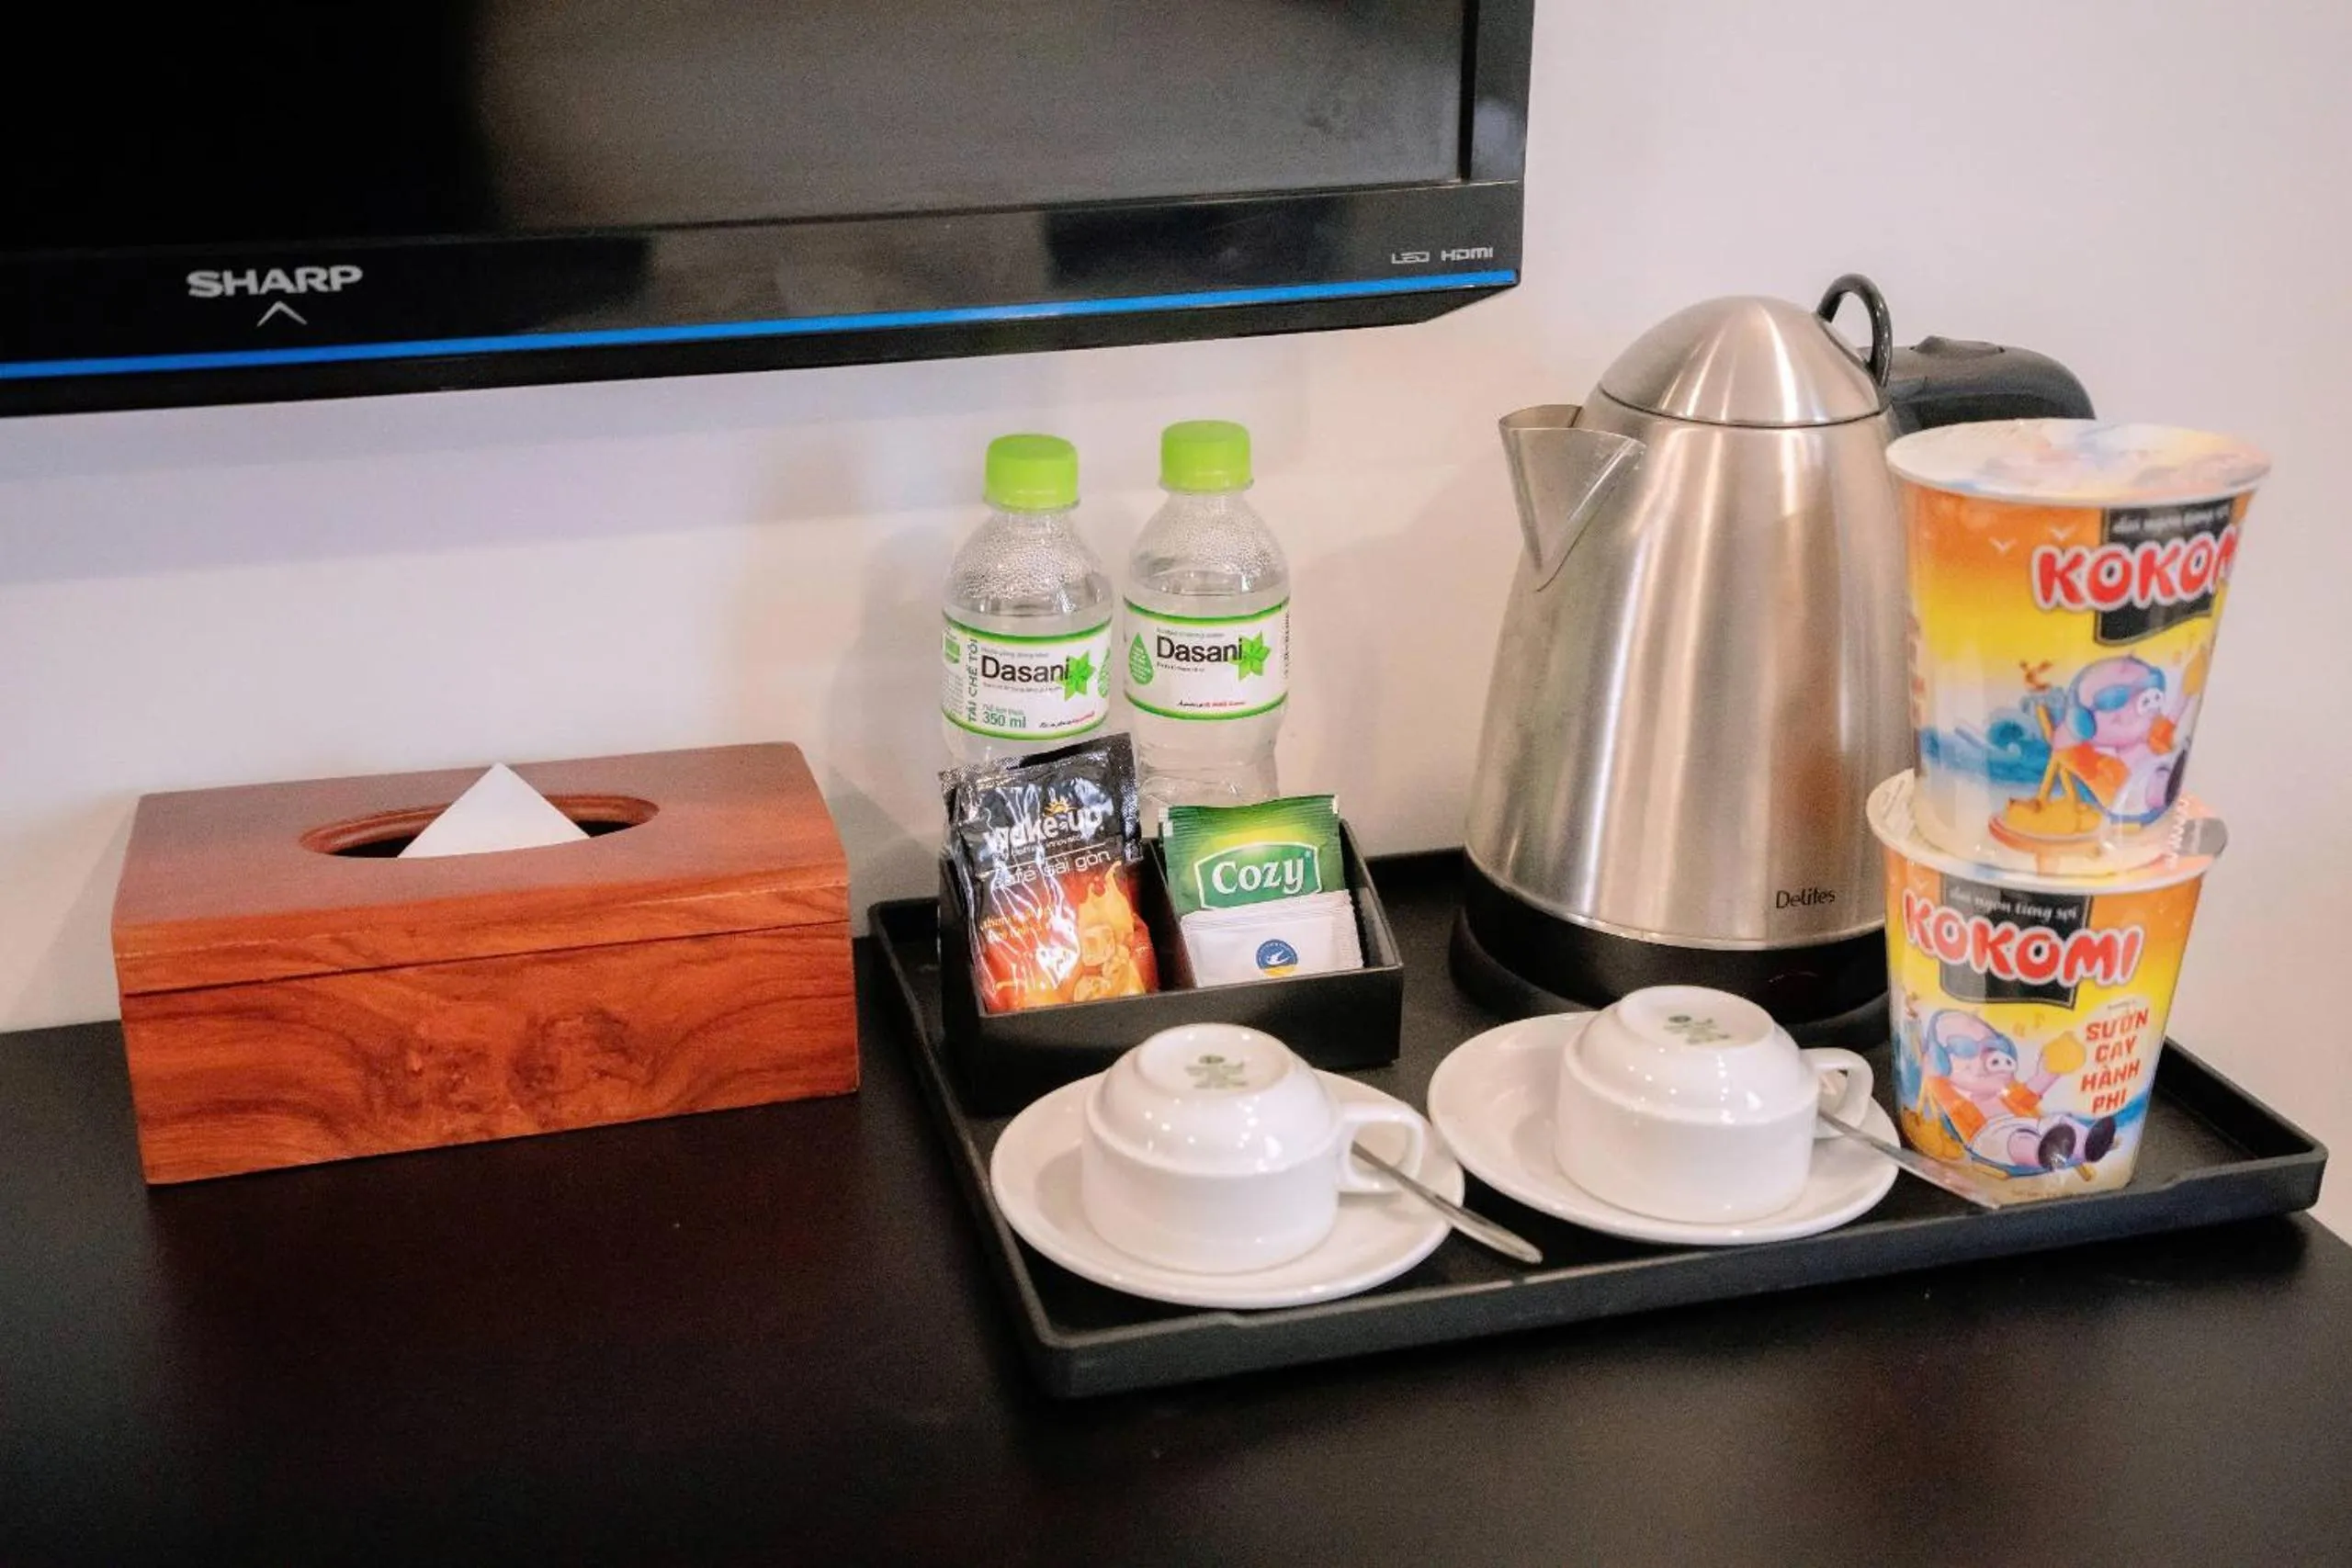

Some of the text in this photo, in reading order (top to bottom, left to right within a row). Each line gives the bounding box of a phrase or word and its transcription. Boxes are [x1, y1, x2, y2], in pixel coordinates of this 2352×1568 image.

[1391, 247, 1493, 264] LED HDMI
[187, 265, 363, 298] SHARP
[1157, 636, 1242, 662] Dasani
[981, 654, 1070, 682] Dasani
[982, 711, 1006, 727] 350
[1009, 716, 1027, 728] ml
[1212, 858, 1304, 895] Cozy
[1776, 887, 1836, 908] Delites
[1903, 889, 2143, 987] KOKOMI
[2095, 1036, 2137, 1063] CAY
[2092, 1088, 2127, 1113] PHI
